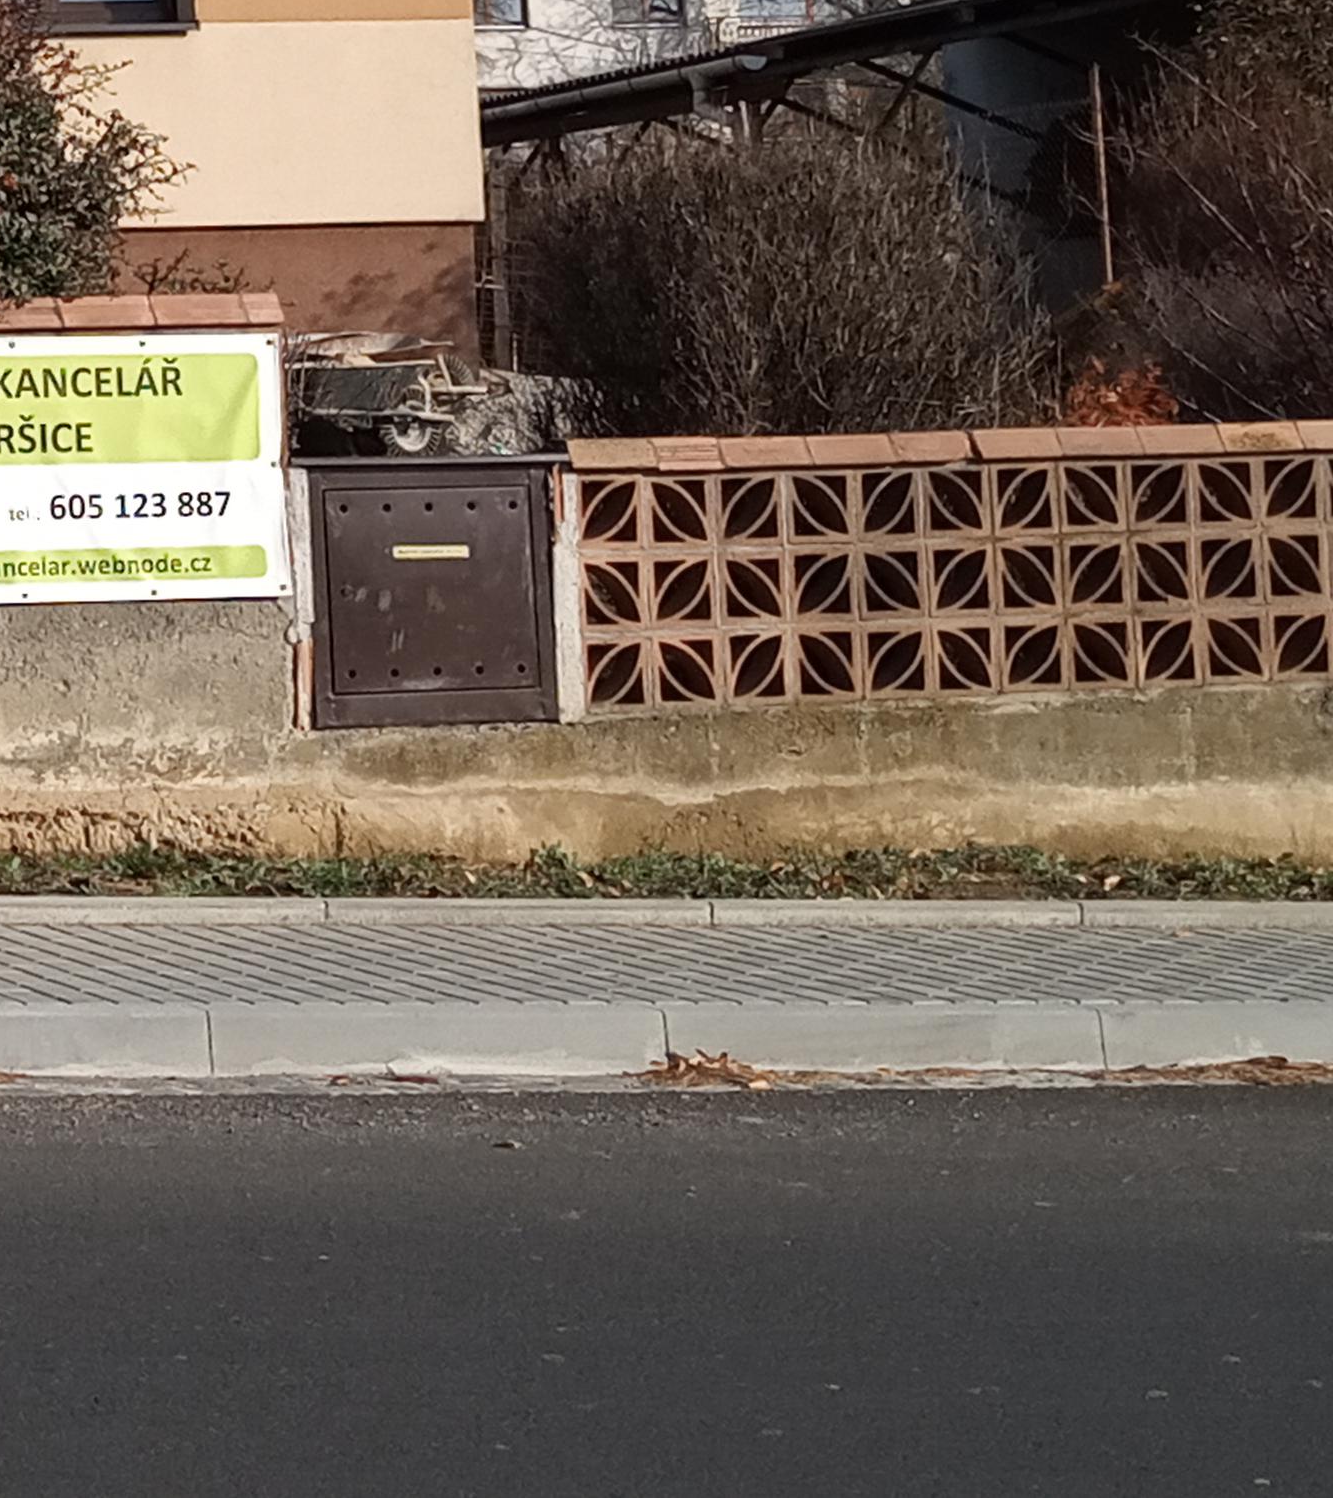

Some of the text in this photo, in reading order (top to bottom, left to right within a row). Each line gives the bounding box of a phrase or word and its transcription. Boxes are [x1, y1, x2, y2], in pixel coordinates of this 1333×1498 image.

[49, 494, 103, 520] 605
[115, 493, 167, 518] 123
[177, 491, 231, 517] 887
